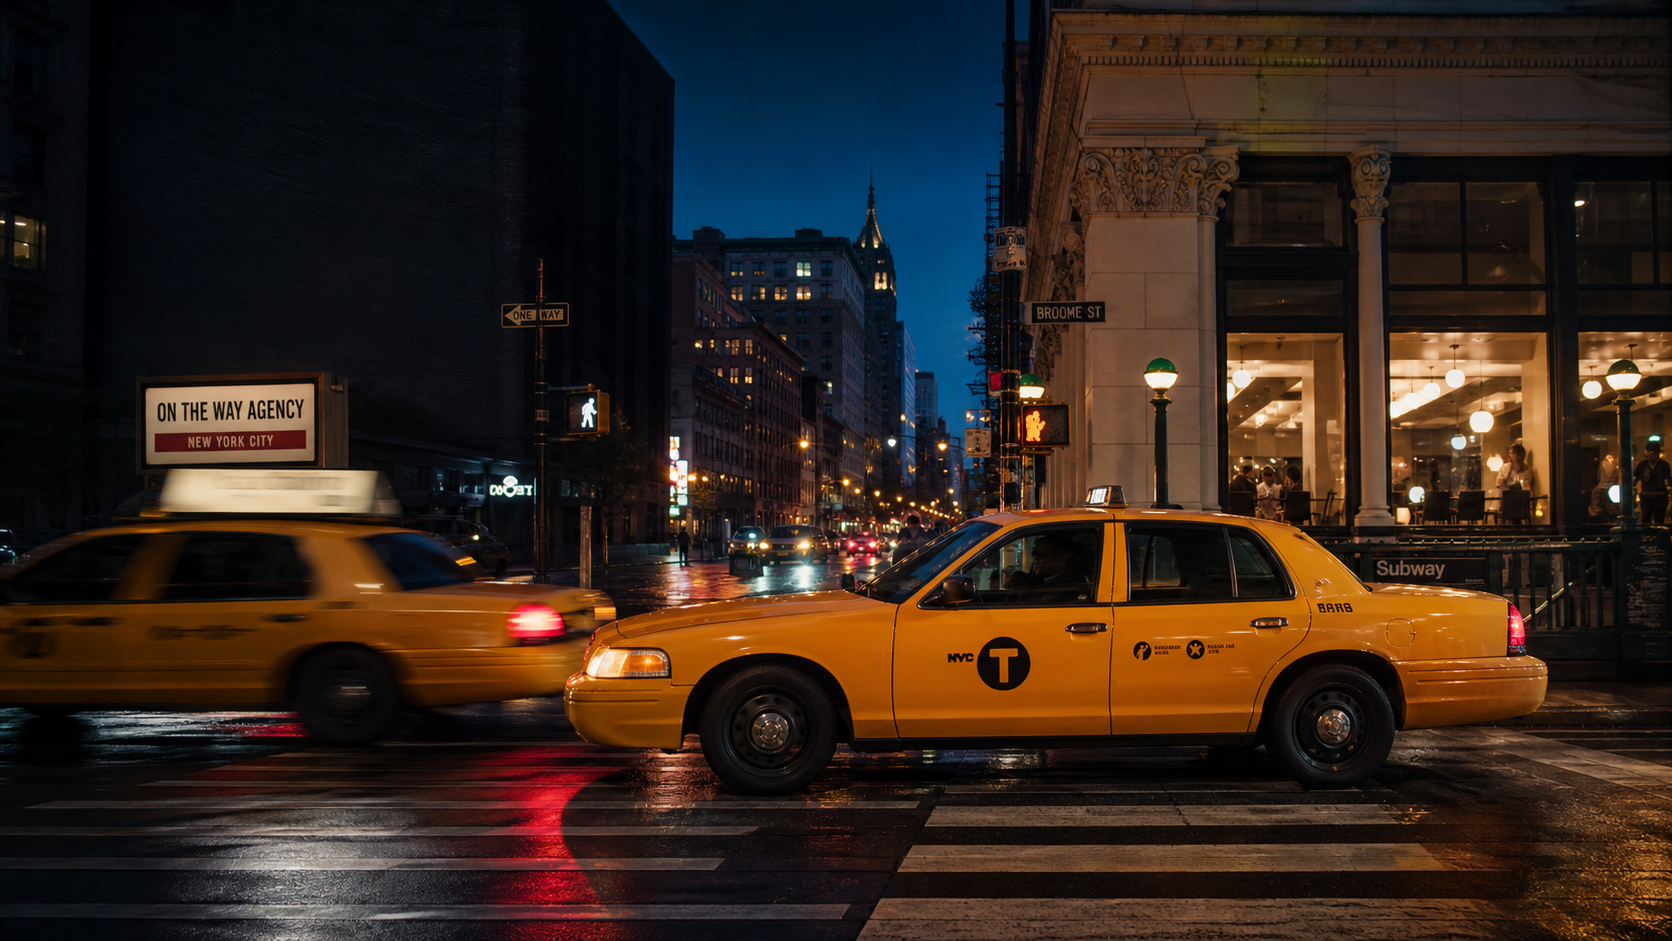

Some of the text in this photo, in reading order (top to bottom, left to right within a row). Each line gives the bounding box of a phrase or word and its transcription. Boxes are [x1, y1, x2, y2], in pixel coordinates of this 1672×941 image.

[513, 309, 560, 320] ONE WAY
[1036, 305, 1101, 319] BROOME ST
[157, 399, 305, 422] ON THE WAY AGENCY
[188, 434, 274, 448] NEW YORK CITY
[1376, 560, 1445, 579] Subway
